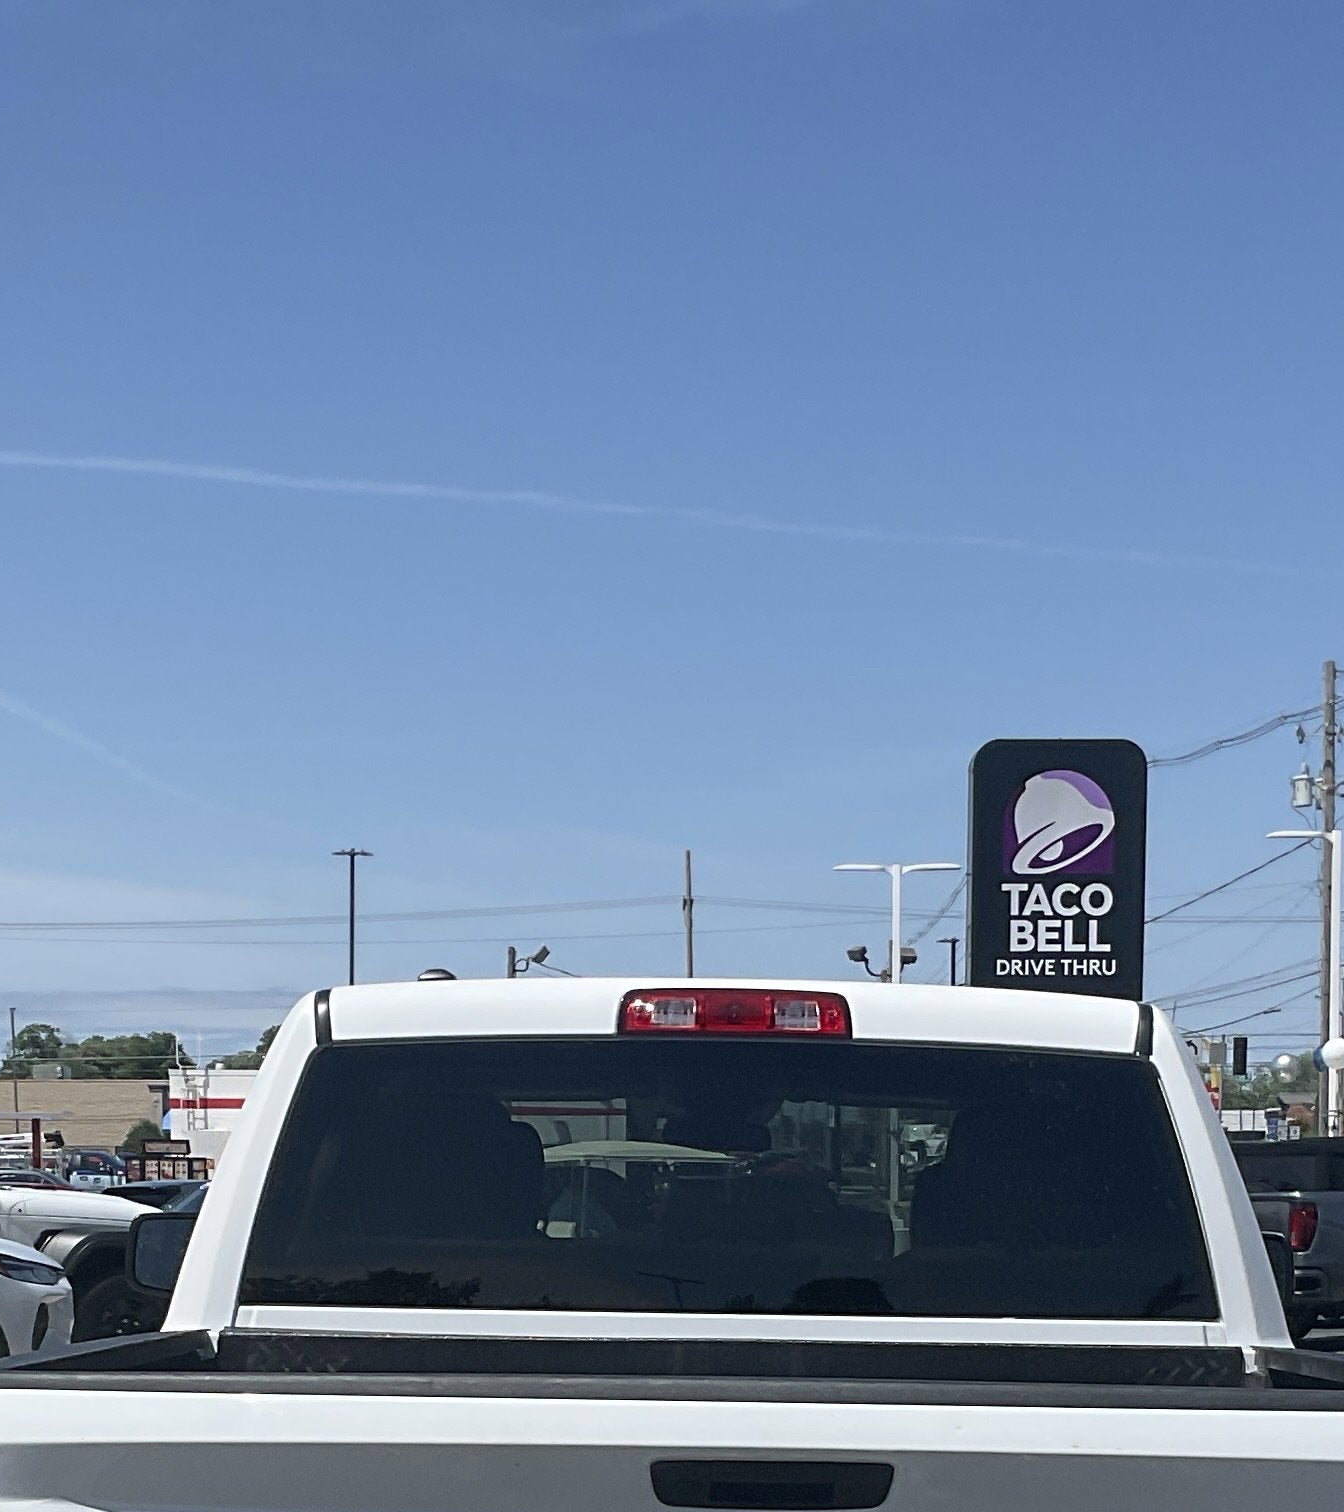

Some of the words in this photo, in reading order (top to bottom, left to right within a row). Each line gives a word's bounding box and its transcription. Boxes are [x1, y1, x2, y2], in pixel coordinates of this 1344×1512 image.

[1001, 882, 1114, 917] TACO
[1009, 919, 1112, 953] BELL
[996, 959, 1056, 977] DRIVE
[1060, 959, 1117, 977] THRU
